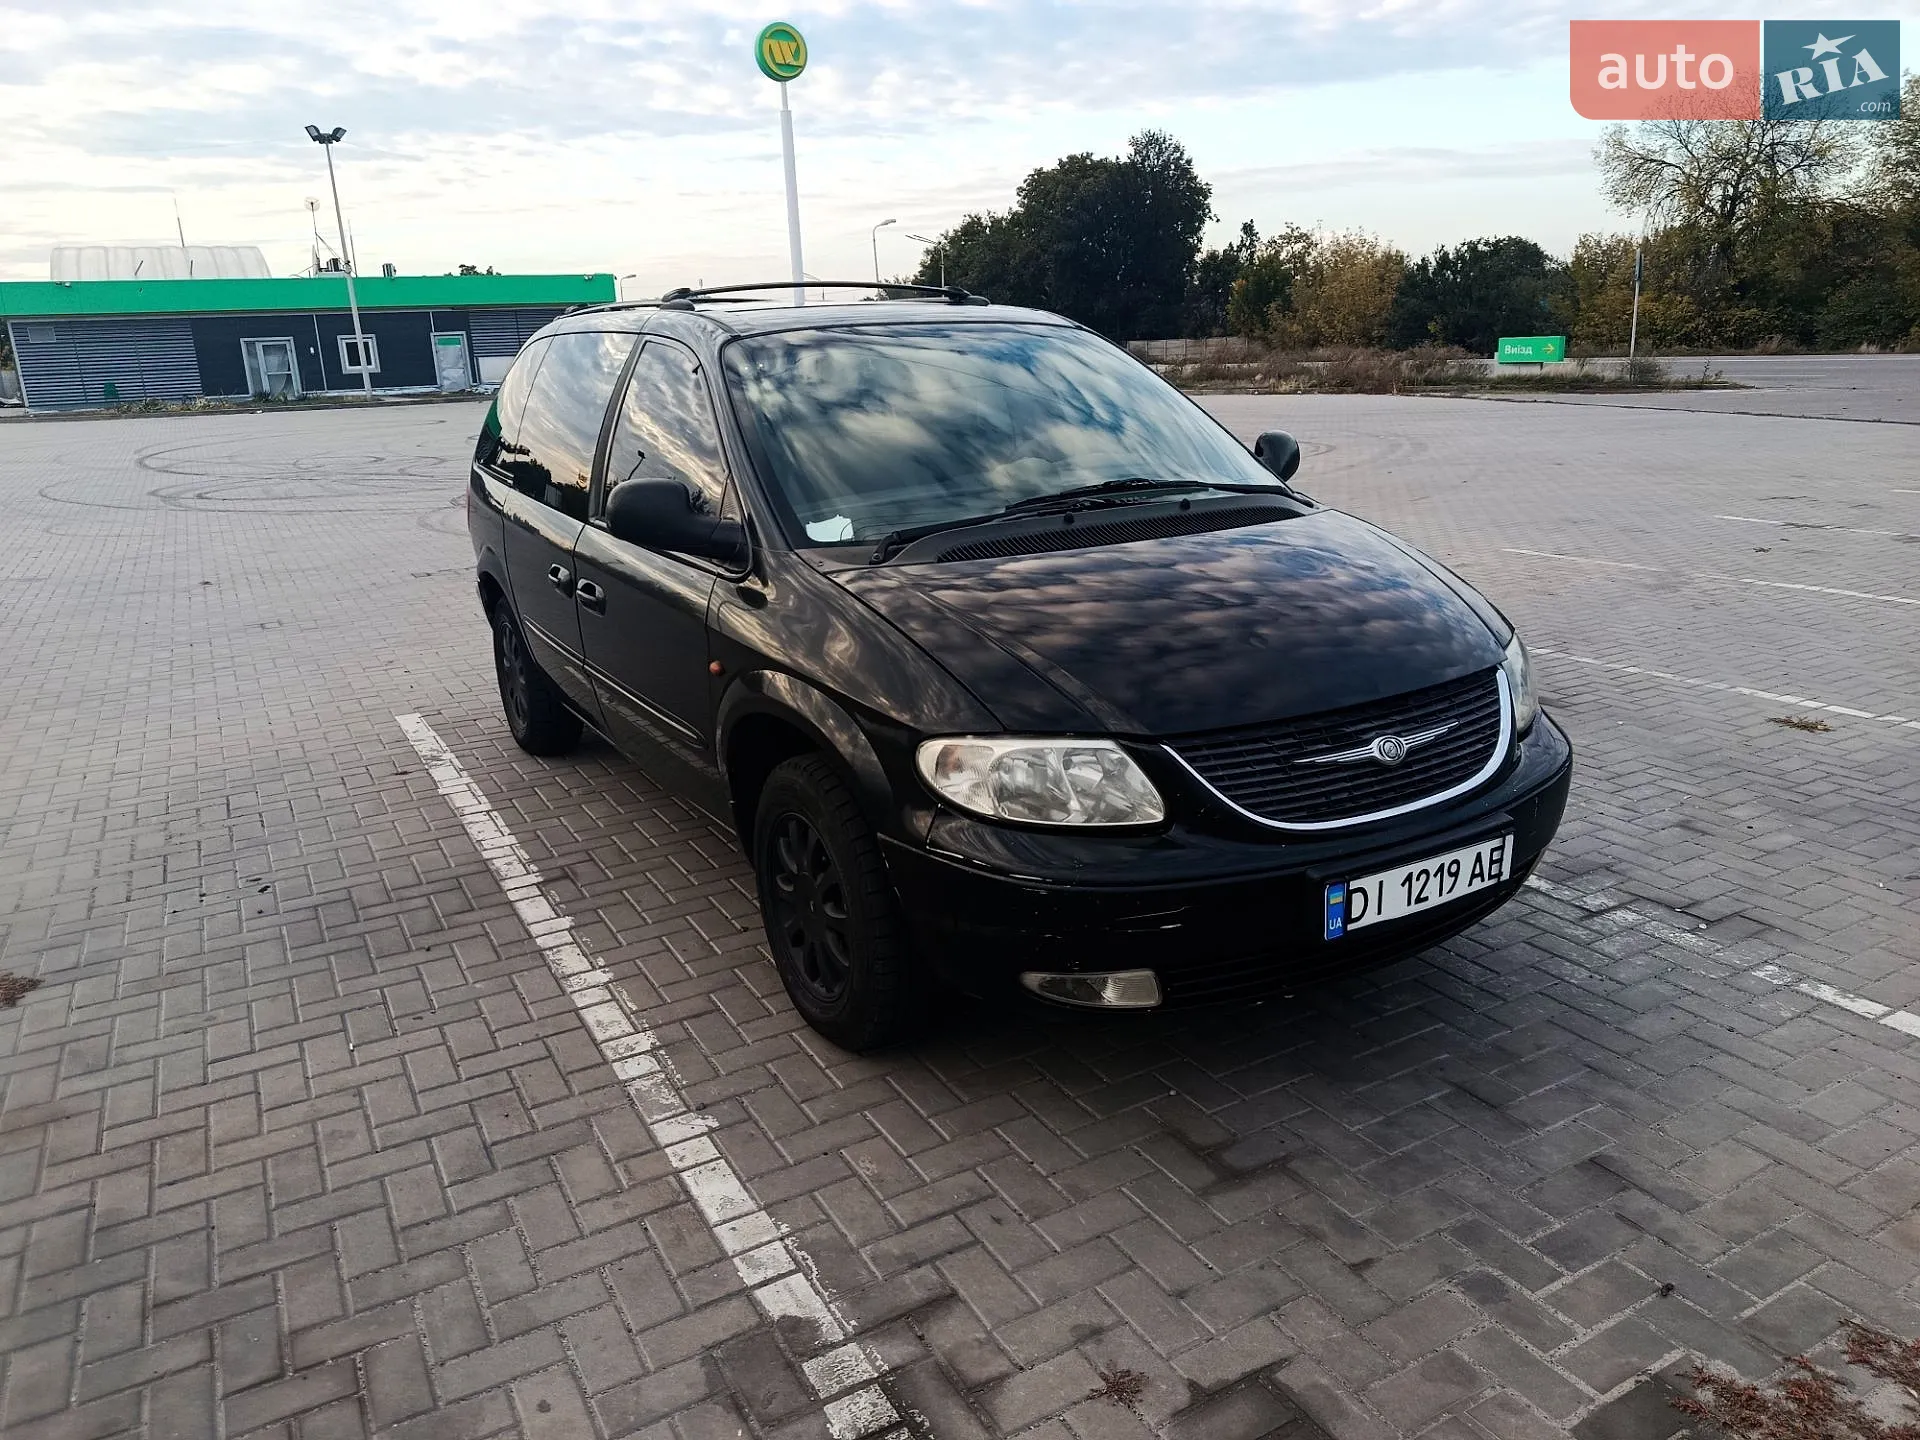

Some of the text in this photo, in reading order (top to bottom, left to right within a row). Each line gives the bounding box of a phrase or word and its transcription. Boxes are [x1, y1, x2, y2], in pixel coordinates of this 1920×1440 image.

[1348, 879, 1384, 924] DI
[1400, 858, 1461, 907] 1219
[1329, 918, 1342, 930] UA
